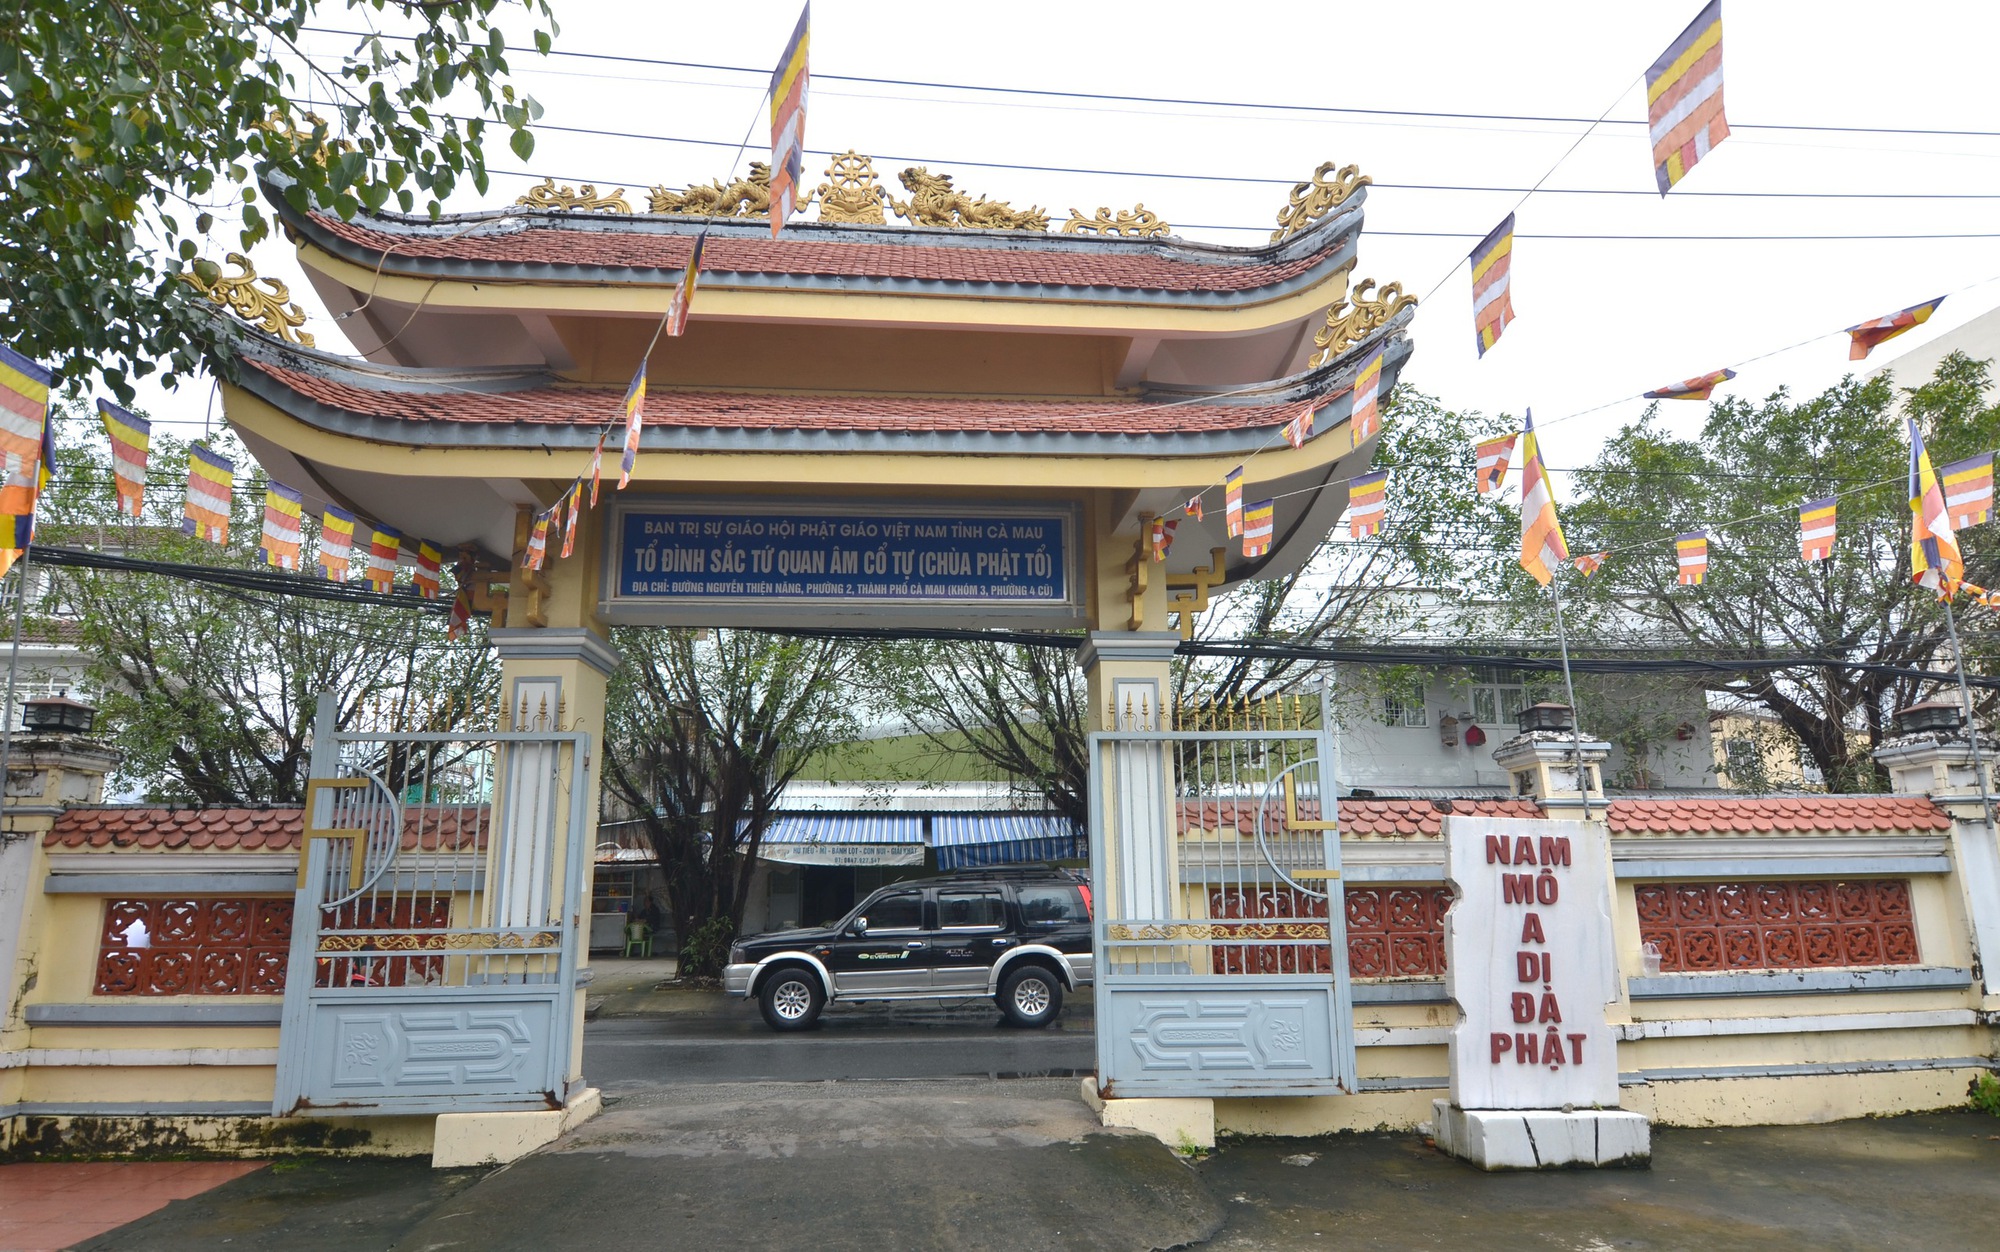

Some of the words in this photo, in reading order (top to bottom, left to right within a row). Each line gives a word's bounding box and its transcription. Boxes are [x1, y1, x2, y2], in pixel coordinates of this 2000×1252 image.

[644, 521, 675, 534] BAN
[679, 522, 699, 538] TRỊ
[703, 521, 723, 538] SỰ
[725, 520, 764, 535] GIÁO
[769, 520, 795, 539] HỘI
[800, 521, 836, 540] PHẬT
[840, 522, 878, 537] GIÁO
[882, 521, 910, 541] VIỆT
[914, 525, 947, 538] NAM
[951, 521, 983, 538] TỈNH
[987, 523, 1008, 539] CÀ
[1012, 526, 1043, 539] MAU
[635, 539, 658, 572] TỔ
[661, 543, 705, 573] ĐÌNH
[710, 541, 746, 573] SẮC
[751, 545, 775, 573] TỨ
[778, 550, 825, 576] QUAN
[829, 546, 858, 574] ÂM
[863, 542, 888, 575] CỔ
[892, 549, 915, 580] TỰ
[919, 547, 972, 578] (CHÙA
[976, 548, 1020, 581] PHẬT
[1024, 544, 1052, 579] TỔ)
[632, 581, 648, 595] ĐỊA
[650, 579, 670, 593] CHỈ:
[671, 580, 704, 593] ĐƯỜNG
[706, 580, 744, 594] NGUYỄN
[746, 581, 773, 596] THIỆN
[806, 581, 844, 595] PHƯỜNG
[846, 584, 855, 596] 2,
[857, 582, 887, 595] THÀNH
[889, 581, 908, 595] PHỐ
[910, 582, 923, 595] CÀ
[925, 584, 946, 595] MAU
[948, 583, 978, 597] (KHÓM
[980, 585, 989, 597] 3,
[991, 583, 1028, 597] PHƯỜNG
[1029, 586, 1036, 596] 4
[1038, 584, 1053, 597] CŨ)
[1485, 835, 1572, 866] NAM
[1502, 868, 1559, 905] MÔ
[1521, 912, 1546, 943] A
[1516, 951, 1552, 983] DI
[1511, 985, 1563, 1024] ĐÀ
[1490, 1026, 1587, 1071] PHẬT
